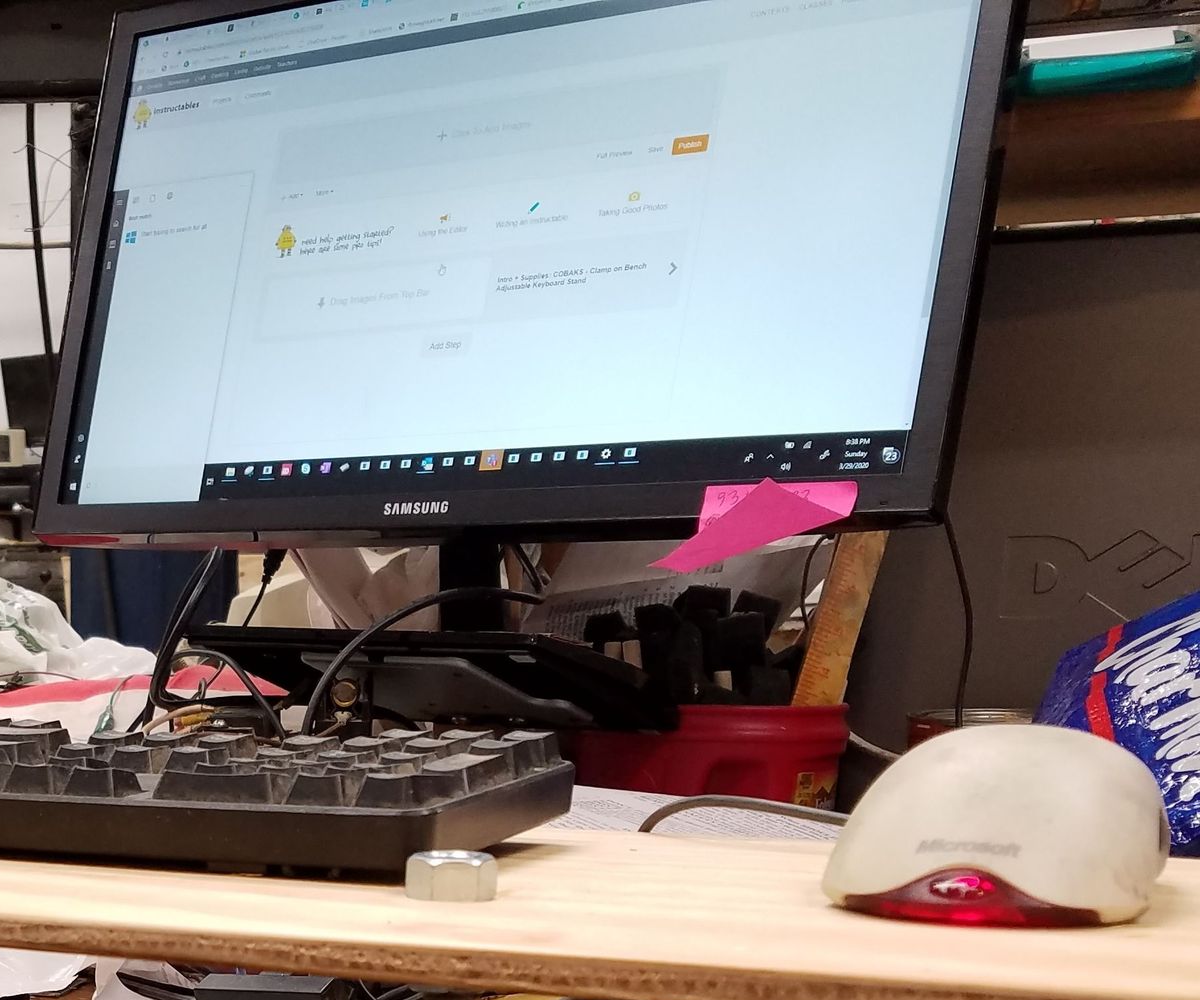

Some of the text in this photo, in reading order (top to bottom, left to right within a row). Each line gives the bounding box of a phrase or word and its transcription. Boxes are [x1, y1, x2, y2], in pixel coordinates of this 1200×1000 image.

[153, 101, 200, 116] instructables
[497, 275, 513, 284] Intro
[589, 266, 612, 277] Clamp
[624, 262, 647, 272] Bench
[496, 277, 587, 293] Adjustable Keyboard Stand
[379, 291, 399, 302] From
[416, 288, 430, 298] Bar
[430, 340, 462, 351] Add Step
[844, 449, 868, 459] Sunday
[383, 501, 450, 517] SAMSUNG
[915, 839, 1022, 858] Microsoft
